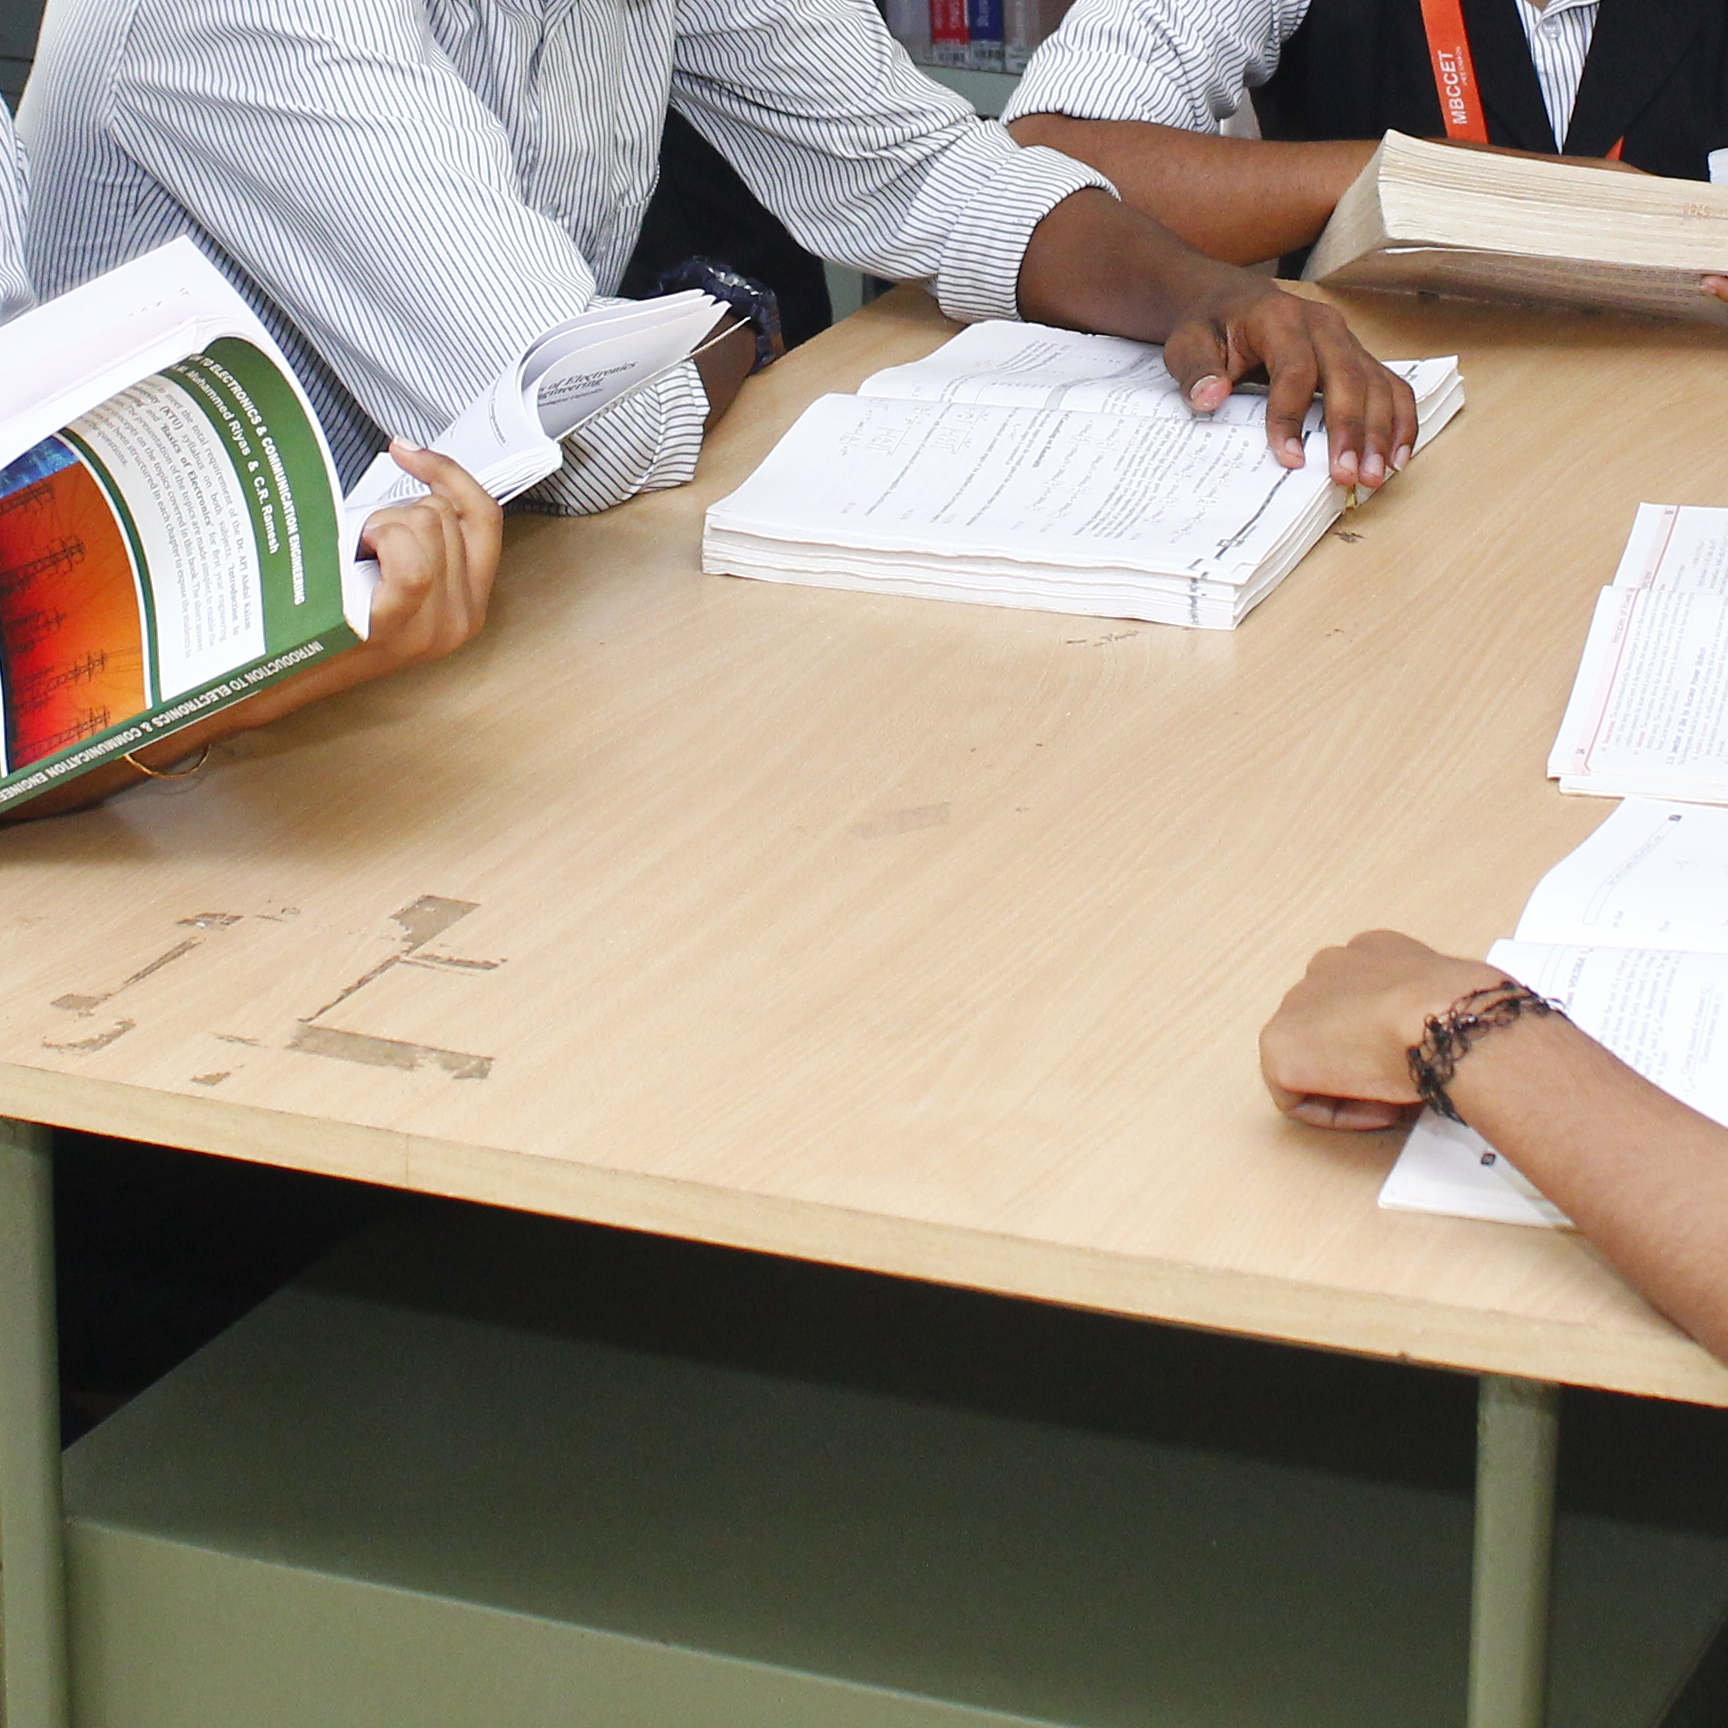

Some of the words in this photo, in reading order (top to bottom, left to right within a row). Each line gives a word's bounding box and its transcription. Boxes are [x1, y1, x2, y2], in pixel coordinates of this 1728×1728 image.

[1437, 49, 1468, 125] MBCCET
[209, 364, 263, 425] ELECTRONICS
[565, 360, 639, 385] Electronics
[180, 407, 194, 424] the
[185, 369, 235, 422] Muhammed
[191, 423, 210, 447] total
[227, 419, 252, 458] Riyas
[255, 425, 269, 438] &
[135, 414, 175, 467] presentation
[173, 472, 187, 491] the
[181, 489, 197, 522] topics
[191, 520, 203, 537] are
[159, 404, 185, 432] (KTU)
[180, 433, 206, 471] syllabus
[203, 474, 213, 489] on
[210, 492, 222, 517] both
[179, 456, 194, 469] of
[204, 447, 235, 506] requirement
[246, 459, 260, 474] &
[126, 444, 161, 491] structured
[157, 500, 171, 526] each
[164, 522, 180, 558] chapter
[135, 434, 147, 449] on
[145, 444, 158, 462] the
[152, 460, 171, 491] topics
[167, 490, 187, 528] covered
[183, 538, 194, 558] this
[252, 475, 270, 505] C.R.
[261, 436, 300, 536] COMMUNICATION
[228, 507, 241, 519] of
[230, 518, 242, 536] the
[261, 503, 282, 556] Ramesh
[287, 533, 307, 607] ENGINEERING
[230, 672, 253, 693] TO
[252, 640, 325, 684] INTRODUCTION
[138, 719, 154, 733] &
[151, 683, 233, 727] ELECTRONICS
[44, 726, 142, 777] COMMUNICATION
